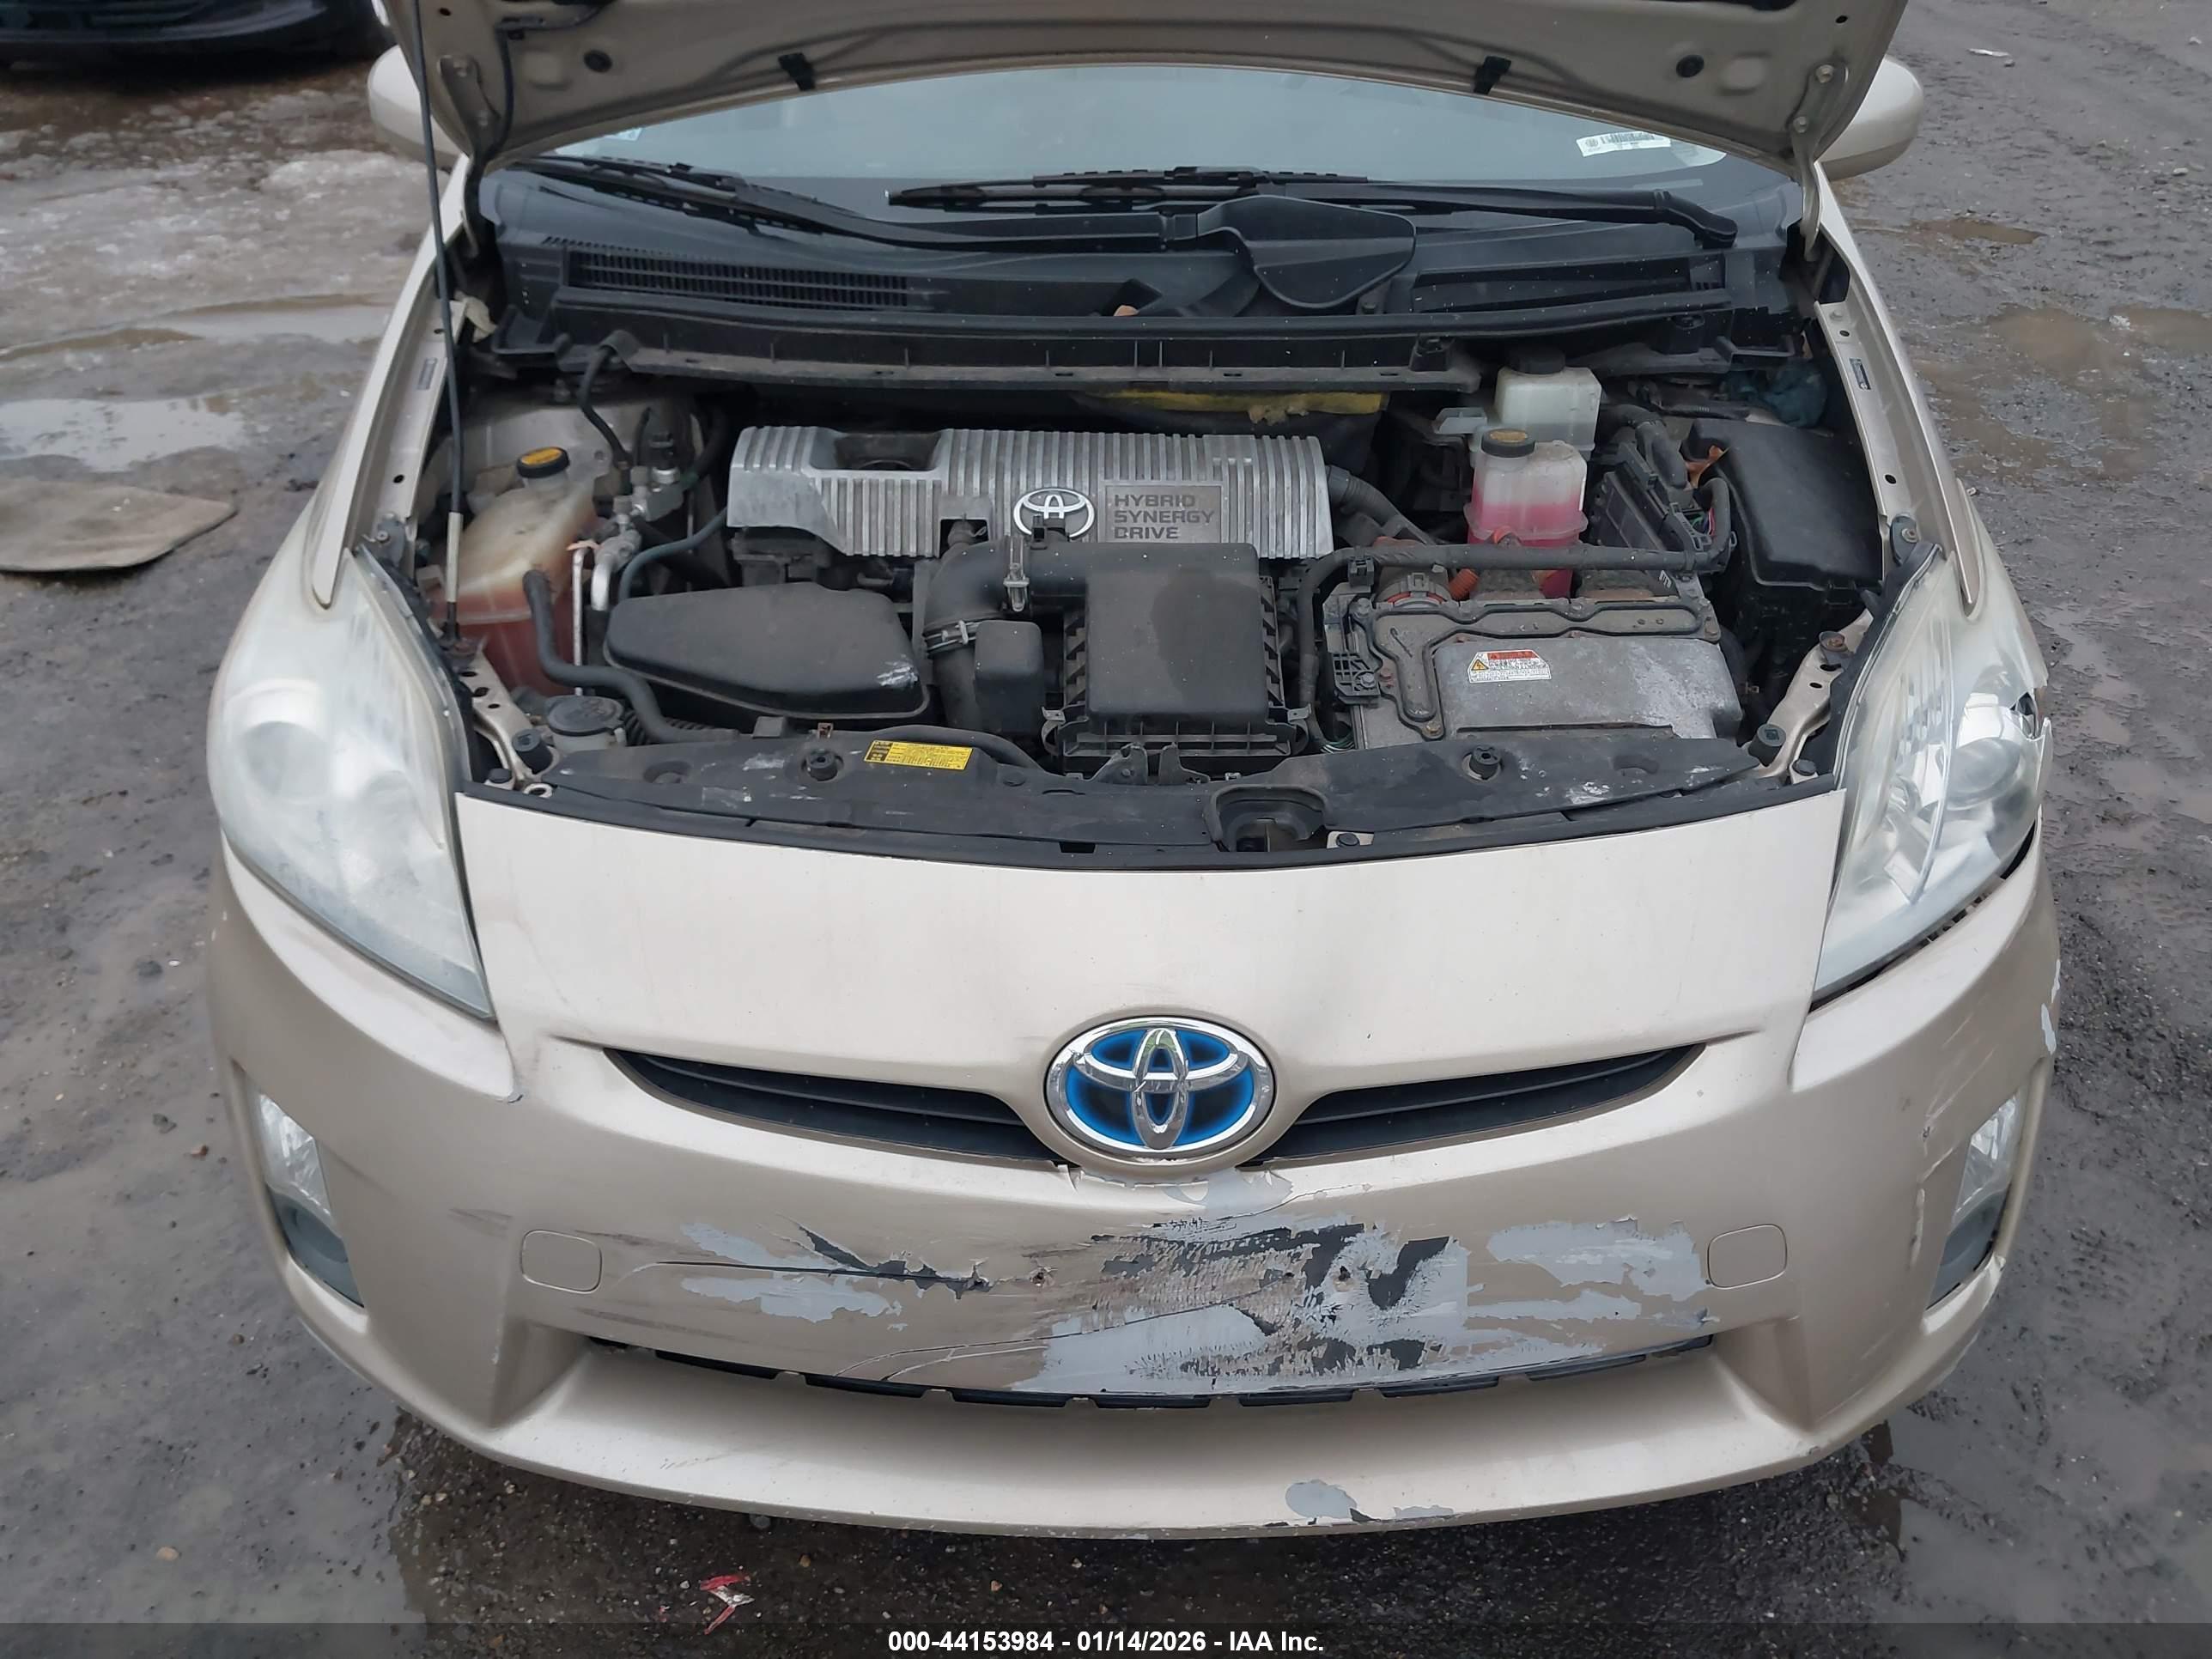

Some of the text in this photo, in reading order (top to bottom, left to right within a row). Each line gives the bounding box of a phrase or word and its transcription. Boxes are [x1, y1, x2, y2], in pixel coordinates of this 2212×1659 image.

[1114, 494, 1196, 507] HYBRID
[1114, 510, 1215, 524] SYNERGY
[1114, 526, 1180, 539] DRIVE
